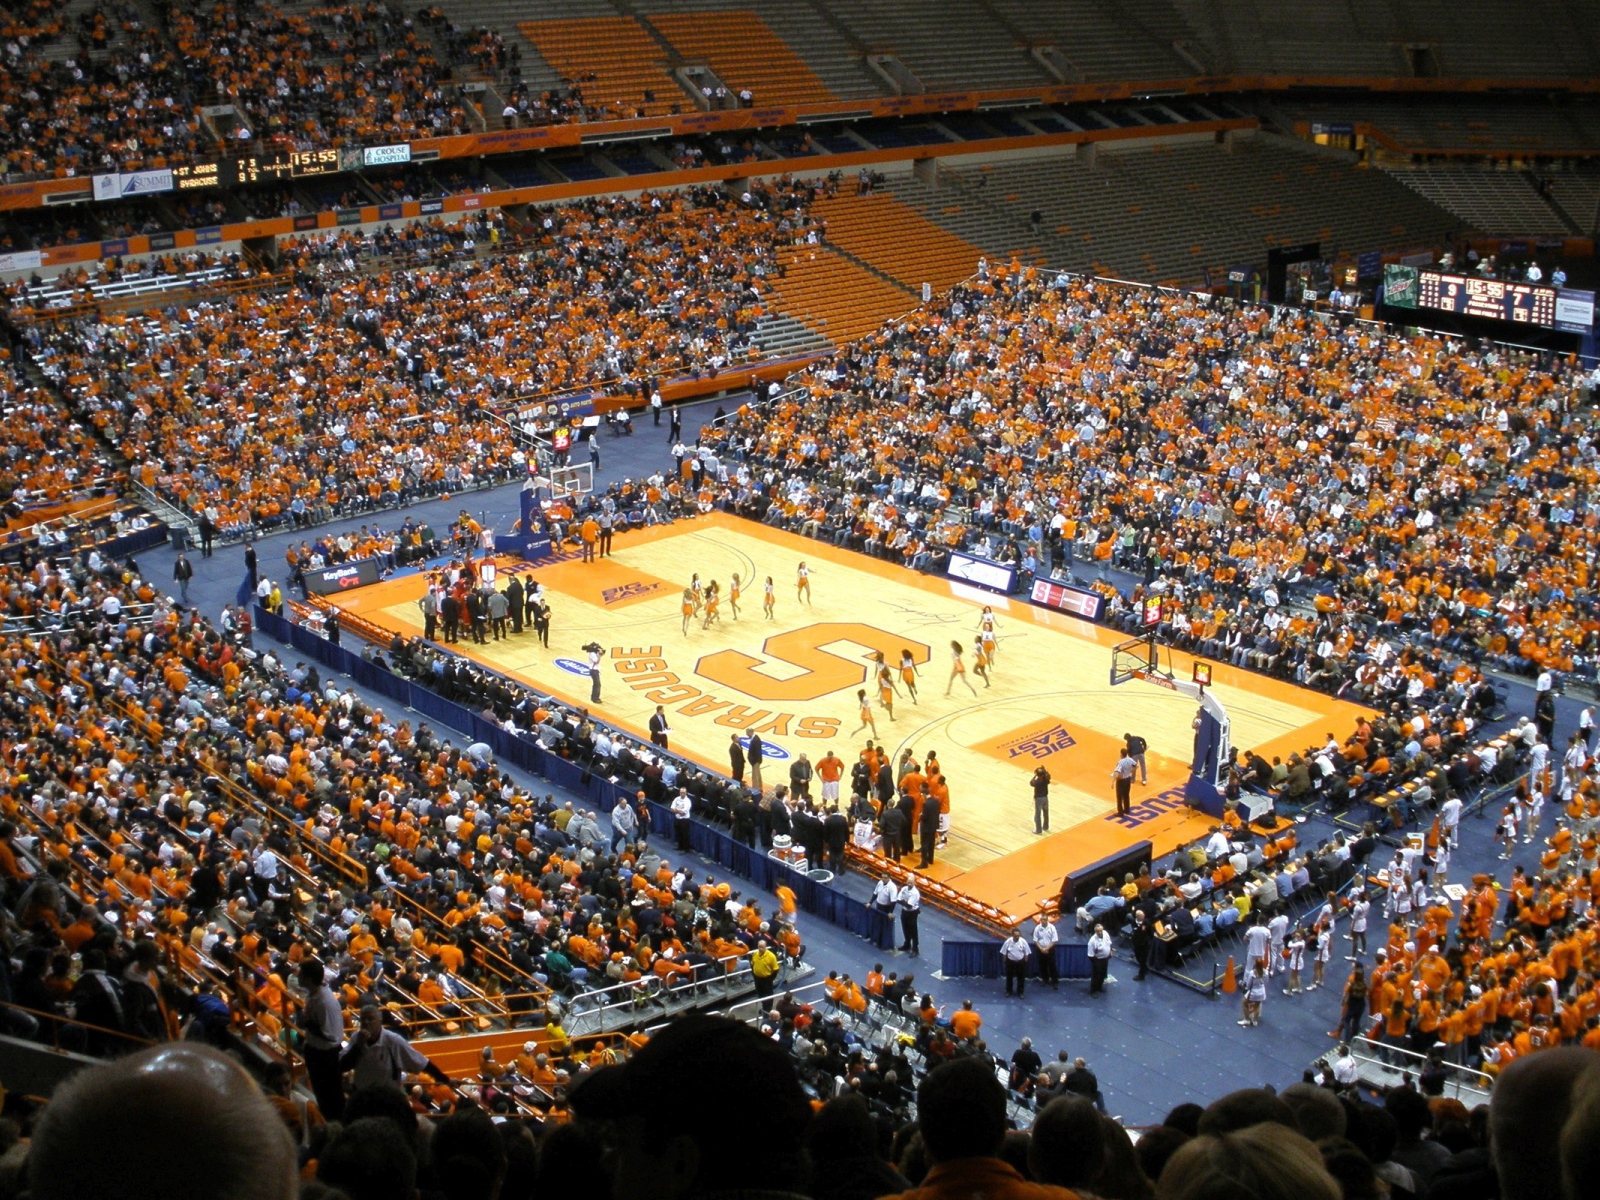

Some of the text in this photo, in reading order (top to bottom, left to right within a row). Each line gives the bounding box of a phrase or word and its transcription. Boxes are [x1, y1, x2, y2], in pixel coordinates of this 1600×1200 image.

[294, 150, 337, 166] 15:55
[373, 154, 409, 164] HOSPITAL
[375, 147, 406, 155] CROUSE
[178, 163, 218, 176] ST JOHNS
[133, 173, 171, 188] SUMMIT
[180, 176, 219, 189] SYRACUSE
[1447, 283, 1457, 297] 9
[1468, 281, 1502, 297] 15:55
[1513, 293, 1522, 306] 7
[323, 566, 358, 581] KeyBank
[601, 581, 642, 597] BIG
[604, 582, 661, 604] EAST
[1035, 582, 1048, 601] S
[1083, 596, 1097, 616] S
[1145, 606, 1161, 622] 35
[693, 622, 932, 702] S
[610, 645, 842, 739] SYRACUSE
[1009, 728, 1069, 759] EAST
[1031, 736, 1077, 760] BIG
